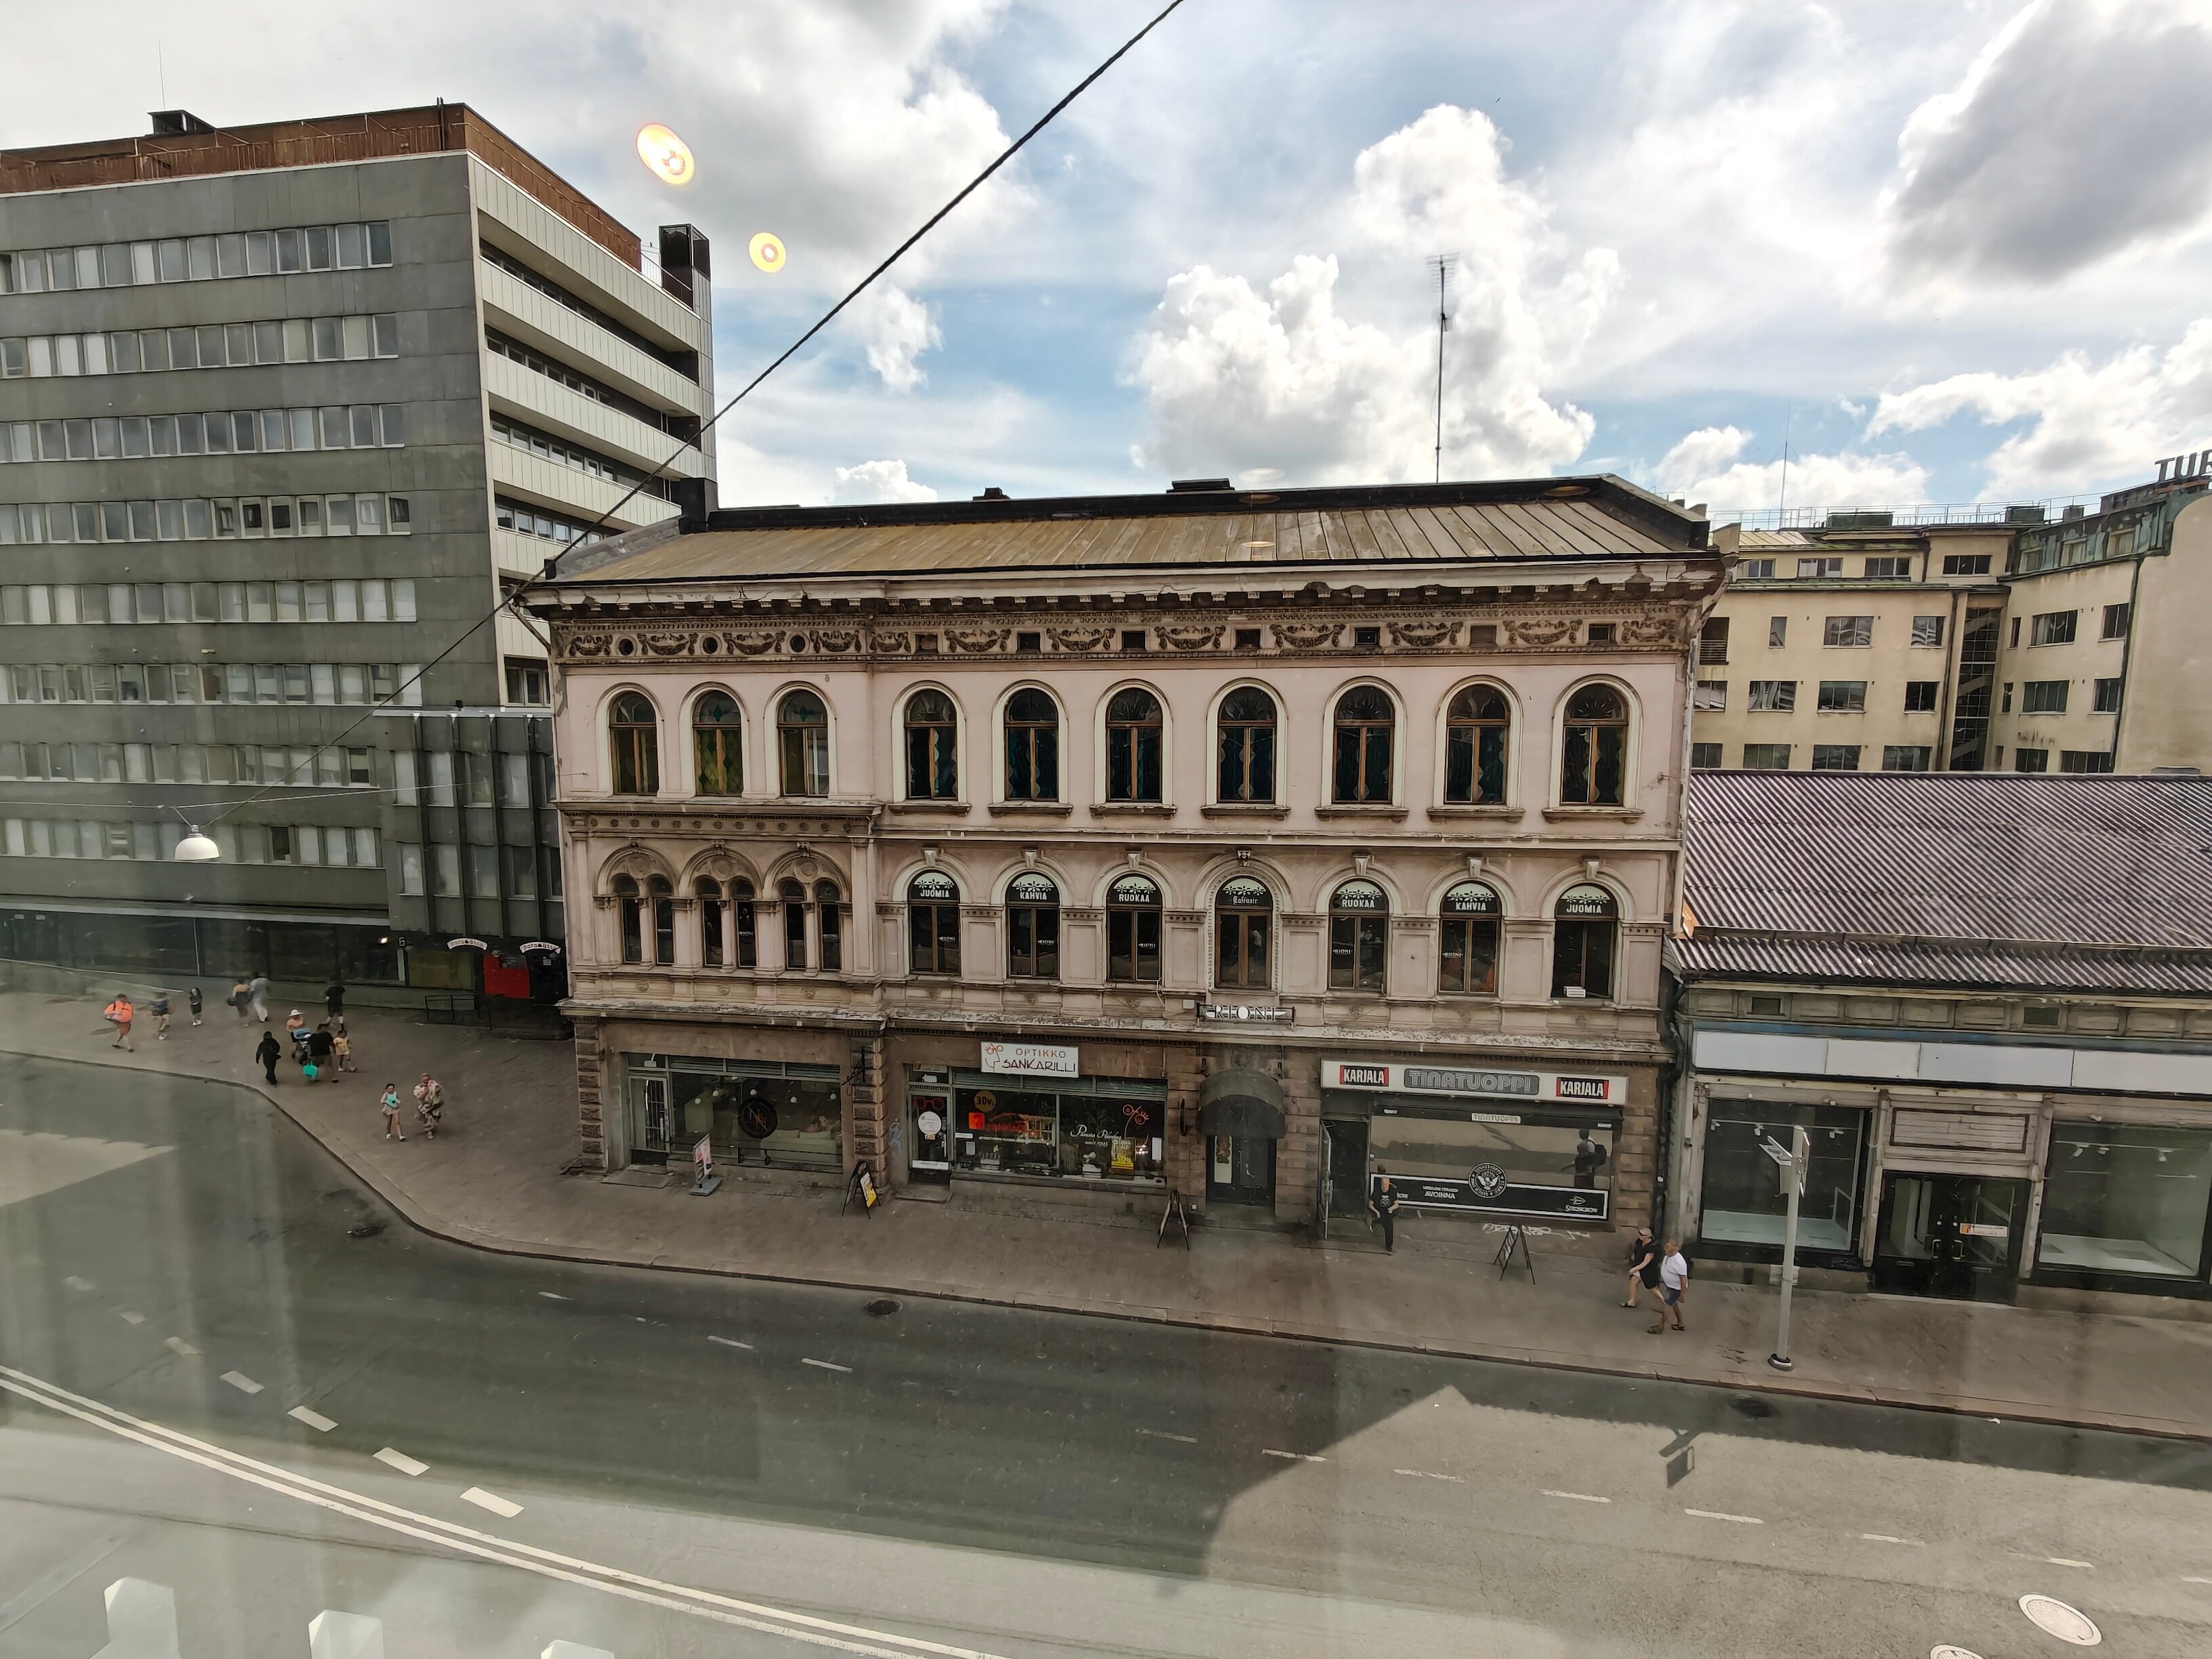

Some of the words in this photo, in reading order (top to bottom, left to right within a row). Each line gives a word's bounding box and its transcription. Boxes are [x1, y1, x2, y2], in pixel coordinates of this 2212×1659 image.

[920, 889, 950, 897] JUOMIA
[1019, 892, 1048, 900] KAHVIA
[1118, 894, 1150, 903] RUOKAA
[1342, 899, 1375, 908] RUOKAA
[1456, 902, 1487, 911] KAHVIA
[1566, 904, 1602, 914] JUOMIA
[1213, 1004, 1276, 1021] RIONI
[1015, 1048, 1066, 1059] OPTIKKO
[1002, 1058, 1076, 1072] SANKARILLI
[1343, 1068, 1385, 1084] KARJALA
[1409, 1069, 1531, 1092] TINATUOPPI
[1560, 1080, 1604, 1097] KARJALA
[976, 1096, 994, 1106] 30v.
[1425, 1191, 1456, 1200] AVOINNA
